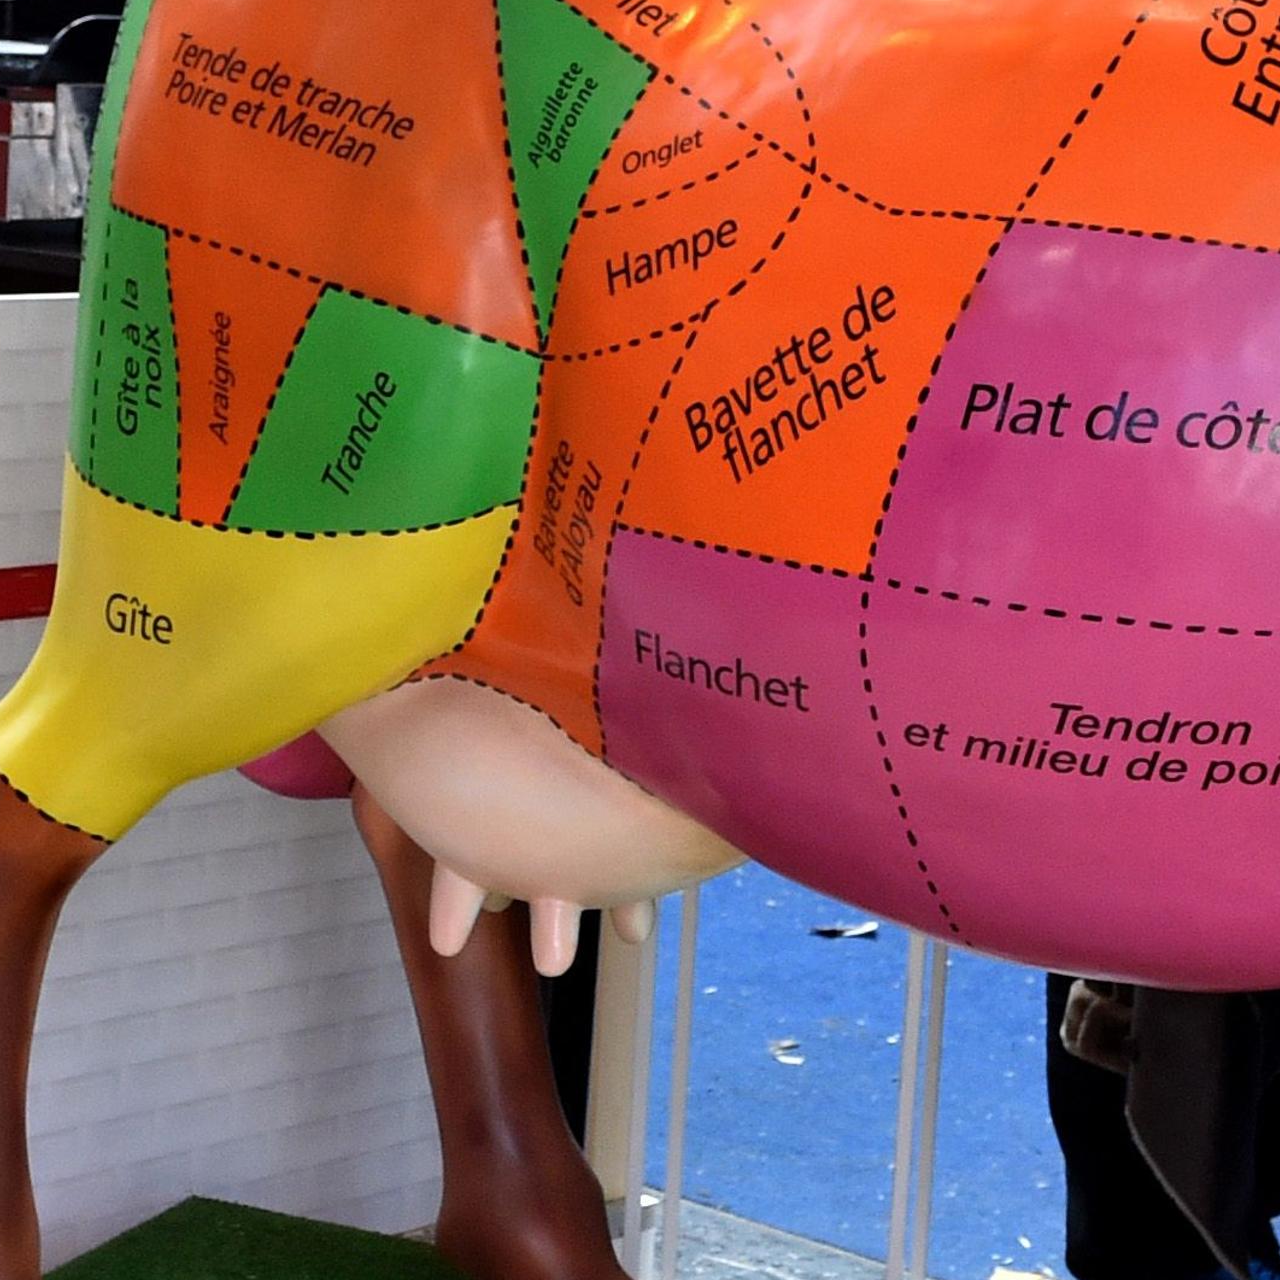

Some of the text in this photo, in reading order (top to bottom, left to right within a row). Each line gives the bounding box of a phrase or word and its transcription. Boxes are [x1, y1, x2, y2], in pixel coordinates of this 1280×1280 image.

[165, 70, 379, 167] Poire et Merlan
[173, 33, 415, 140] Tende de tranche
[528, 60, 585, 169] Aiguillette
[546, 75, 599, 164] baronne
[621, 129, 703, 175] Onglet
[606, 218, 740, 296] Hampe
[116, 277, 141, 437] Gîte à la
[141, 324, 162, 409] noix
[208, 311, 236, 446] Araignée
[684, 283, 898, 454] Bavette de
[321, 370, 397, 496] Tranche
[723, 343, 888, 484] flanchet
[959, 382, 1072, 437] Plat
[1084, 390, 1160, 444] de
[532, 439, 576, 568] Bavette
[105, 593, 173, 645] Gîte
[634, 628, 810, 713] Flanchet
[903, 722, 949, 751] et
[963, 735, 1109, 778] milieu
[1125, 751, 1188, 783] de
[1049, 702, 1252, 746] Tendron
